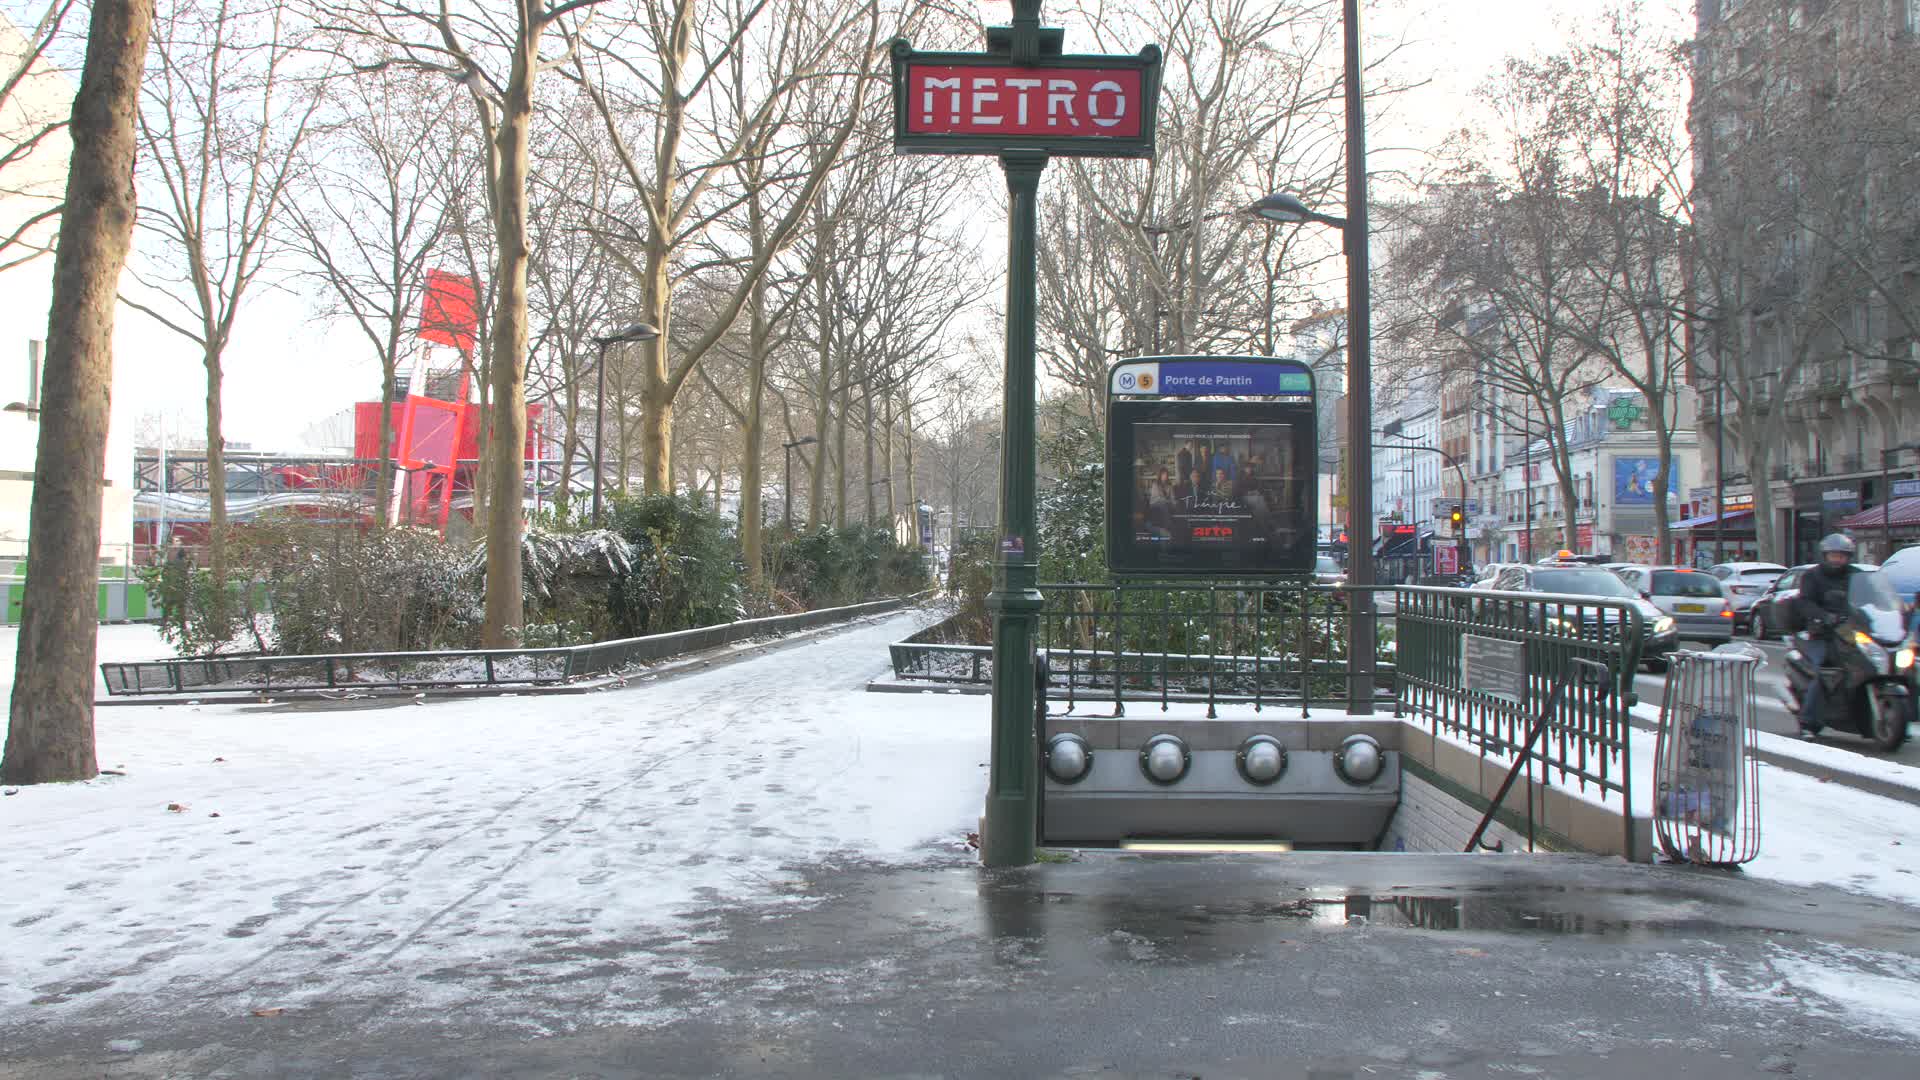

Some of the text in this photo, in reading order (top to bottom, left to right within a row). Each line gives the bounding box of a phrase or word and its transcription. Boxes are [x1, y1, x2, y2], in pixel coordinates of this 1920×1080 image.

[923, 76, 1126, 127] METRO
[1165, 375, 1196, 386] Porte
[1198, 375, 1212, 386] de
[1216, 375, 1253, 386] Pantin
[1193, 526, 1233, 537] arte
